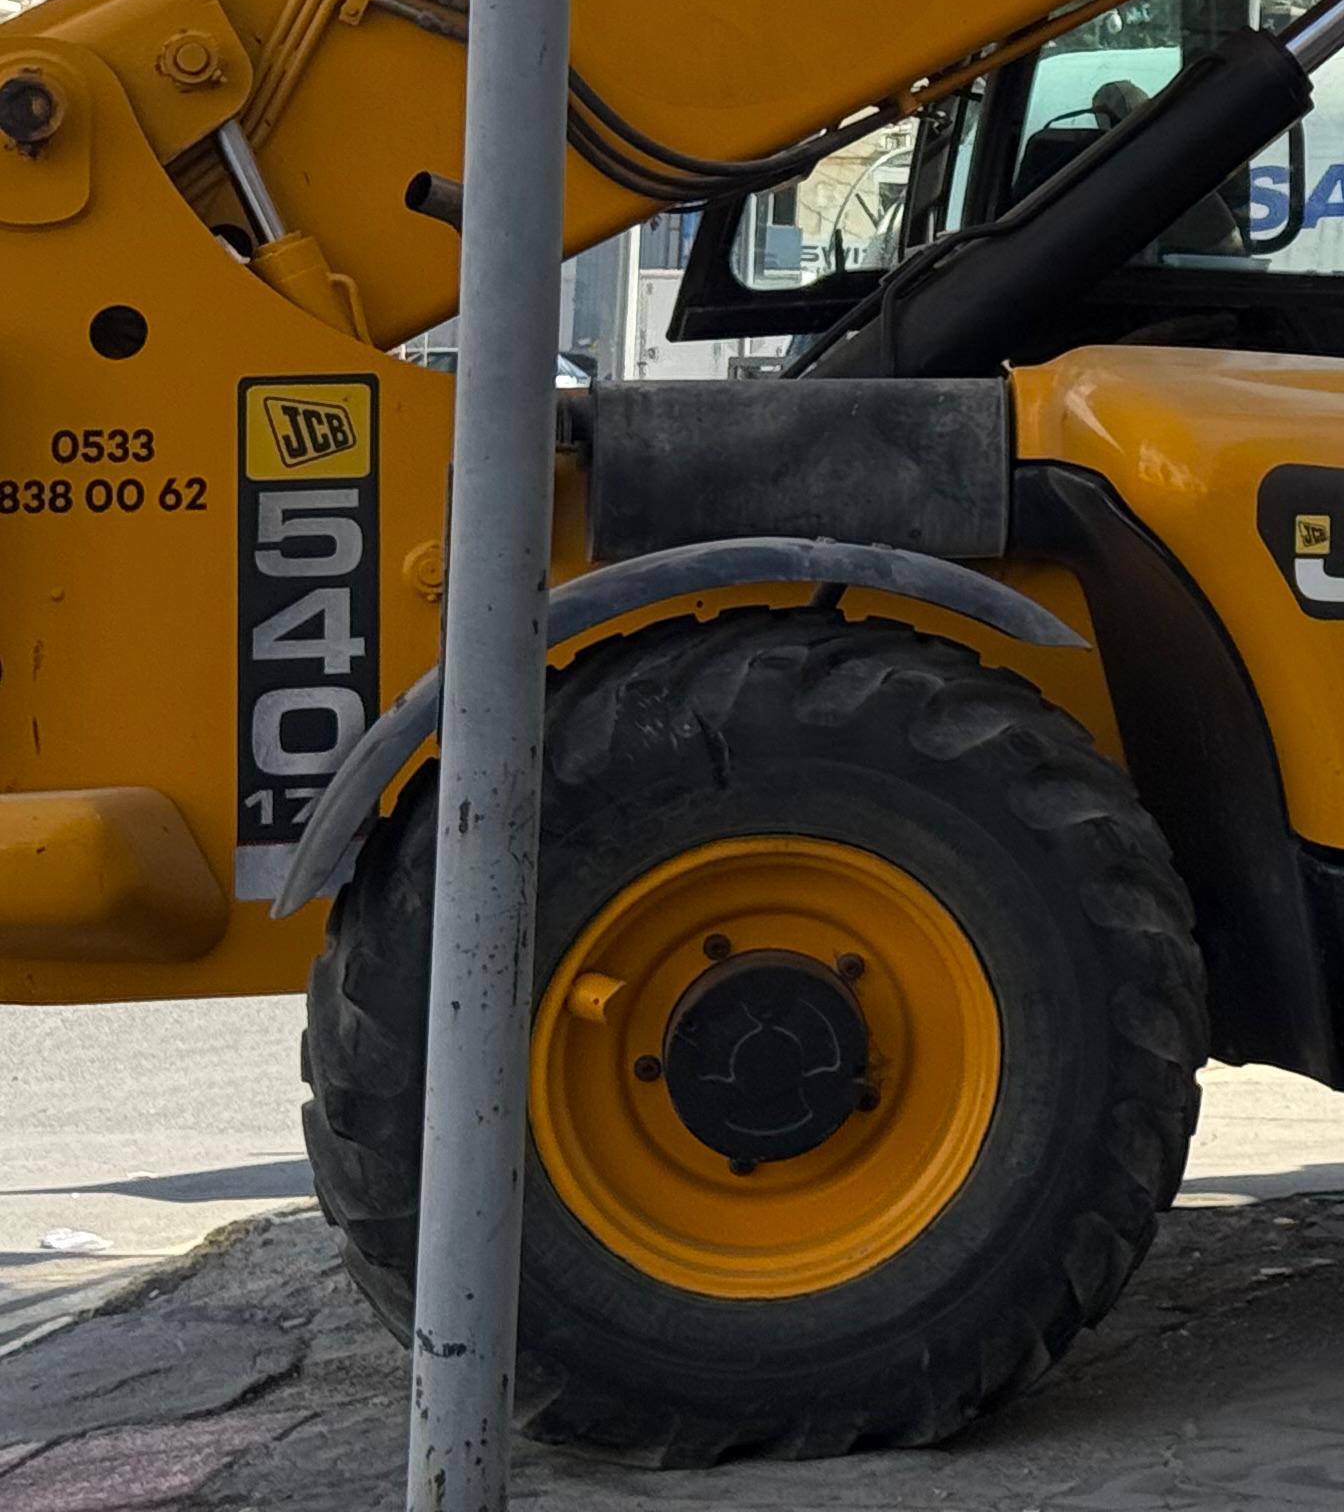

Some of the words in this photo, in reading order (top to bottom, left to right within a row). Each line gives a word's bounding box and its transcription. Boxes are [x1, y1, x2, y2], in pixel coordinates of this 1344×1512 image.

[52, 429, 154, 463] 0533
[281, 403, 350, 459] JCB
[0, 480, 72, 513] 838
[86, 479, 144, 513] 00
[159, 477, 208, 511] 62
[252, 489, 365, 778] 540
[245, 789, 325, 825] 17
